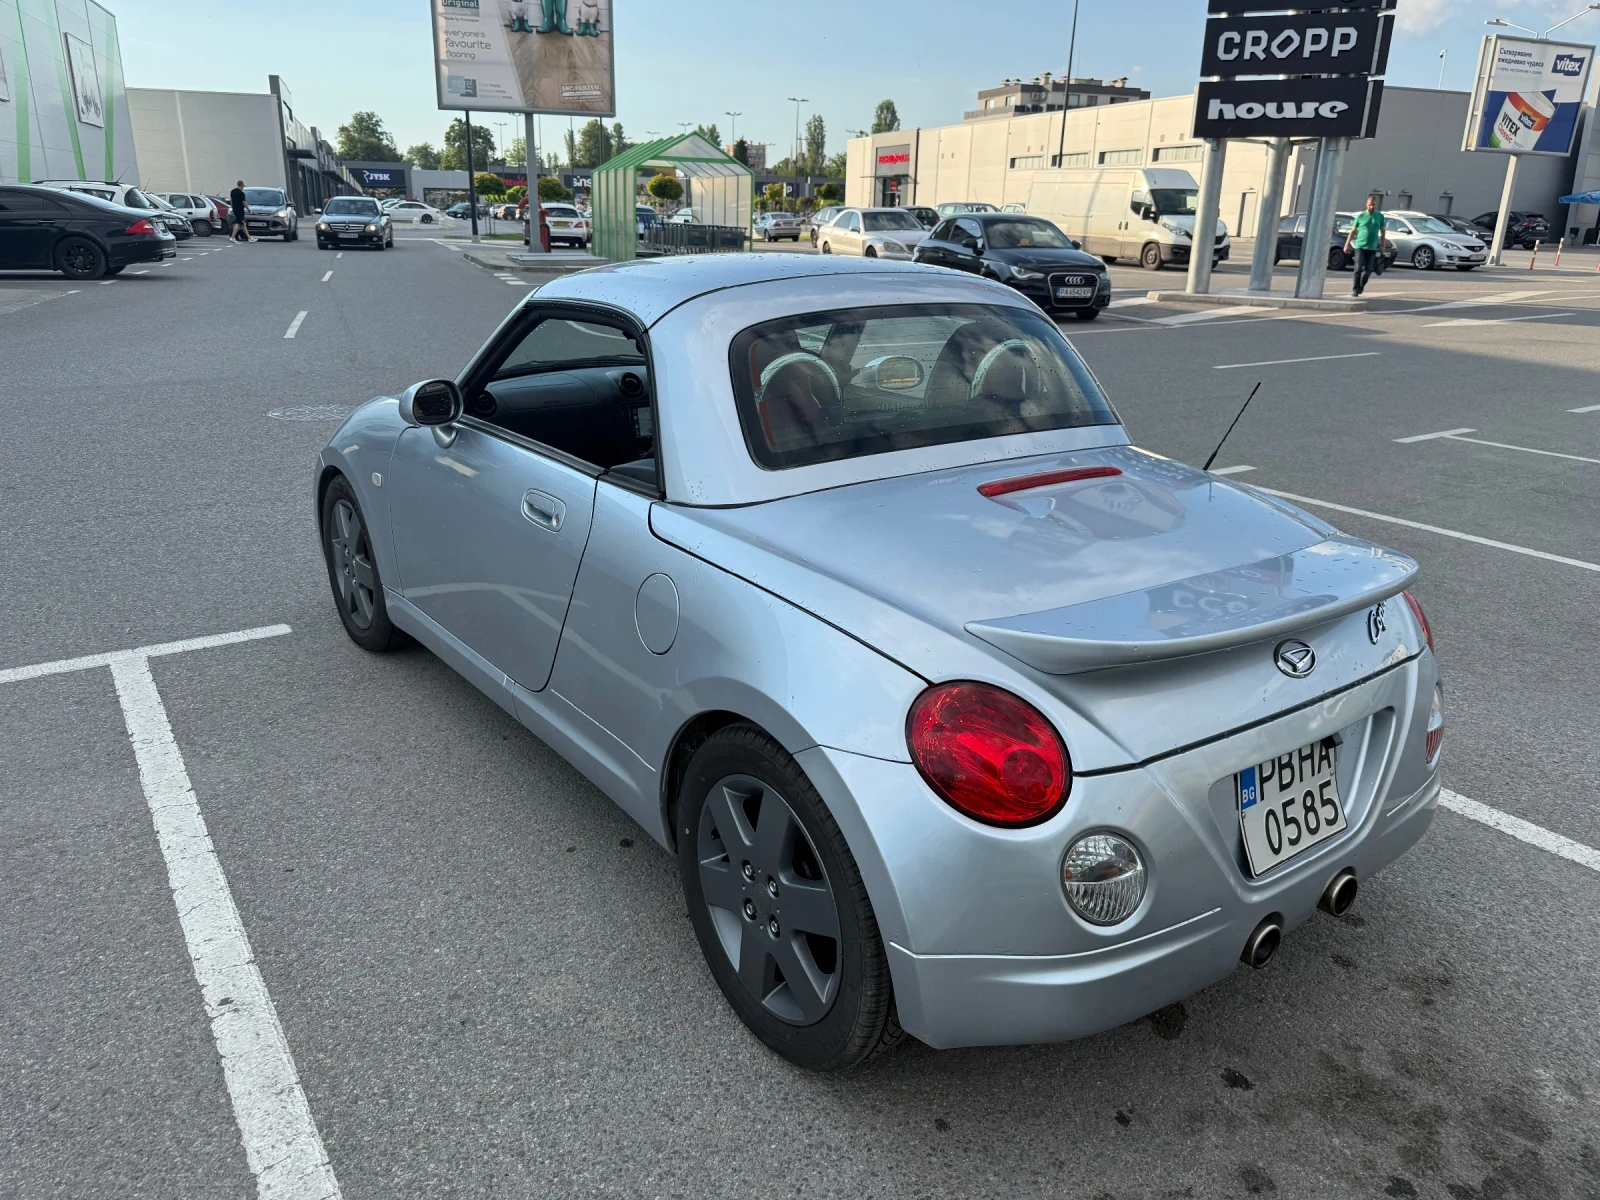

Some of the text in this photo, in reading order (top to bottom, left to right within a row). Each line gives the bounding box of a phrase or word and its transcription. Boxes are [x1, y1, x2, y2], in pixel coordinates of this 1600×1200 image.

[444, 30, 486, 38] everyone's
[445, 38, 492, 50] favourite
[1217, 27, 1358, 61] CROPP
[445, 50, 476, 60] flooring
[1556, 57, 1581, 72] vitex
[1207, 99, 1349, 120] house
[1502, 111, 1520, 138] VITEX
[1520, 113, 1534, 128] vitex
[1498, 122, 1513, 144] Classic
[369, 173, 391, 181] JYSK
[573, 176, 591, 187] sins
[1258, 743, 1332, 802] PBHA
[1242, 786, 1255, 803] BG
[1264, 779, 1339, 855] 0585
